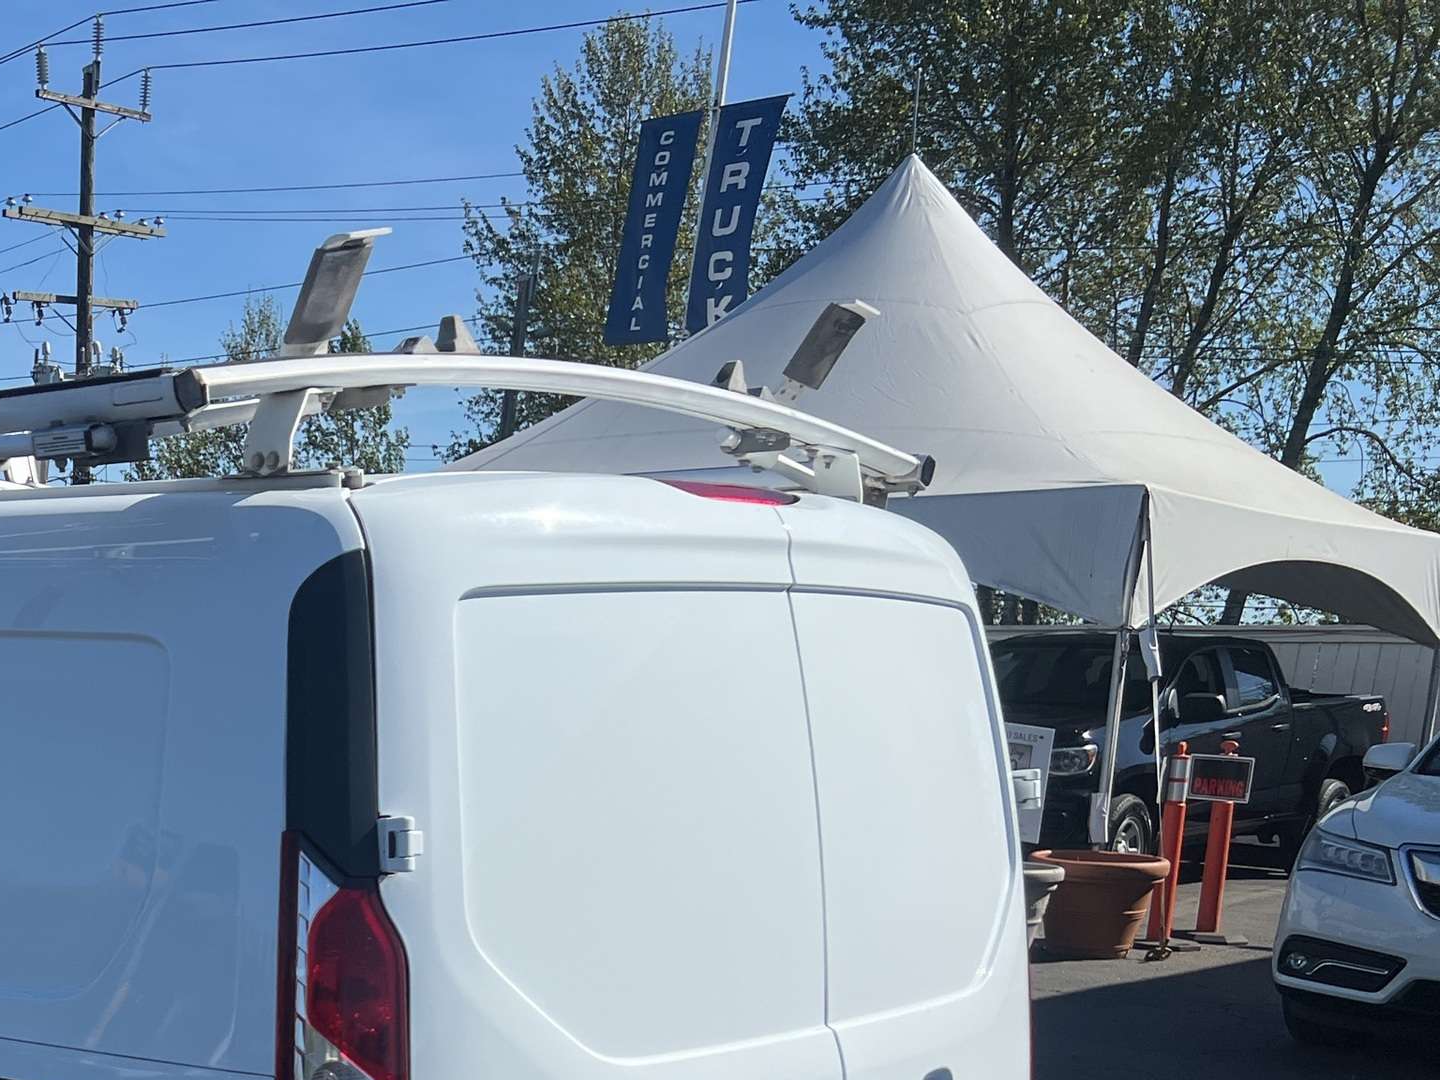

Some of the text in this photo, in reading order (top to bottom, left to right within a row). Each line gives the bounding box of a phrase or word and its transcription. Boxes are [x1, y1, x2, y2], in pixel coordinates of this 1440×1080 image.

[629, 130, 676, 332] COMMERCIAL
[706, 117, 762, 327] TRUCK
[1193, 776, 1245, 797] PARKING
